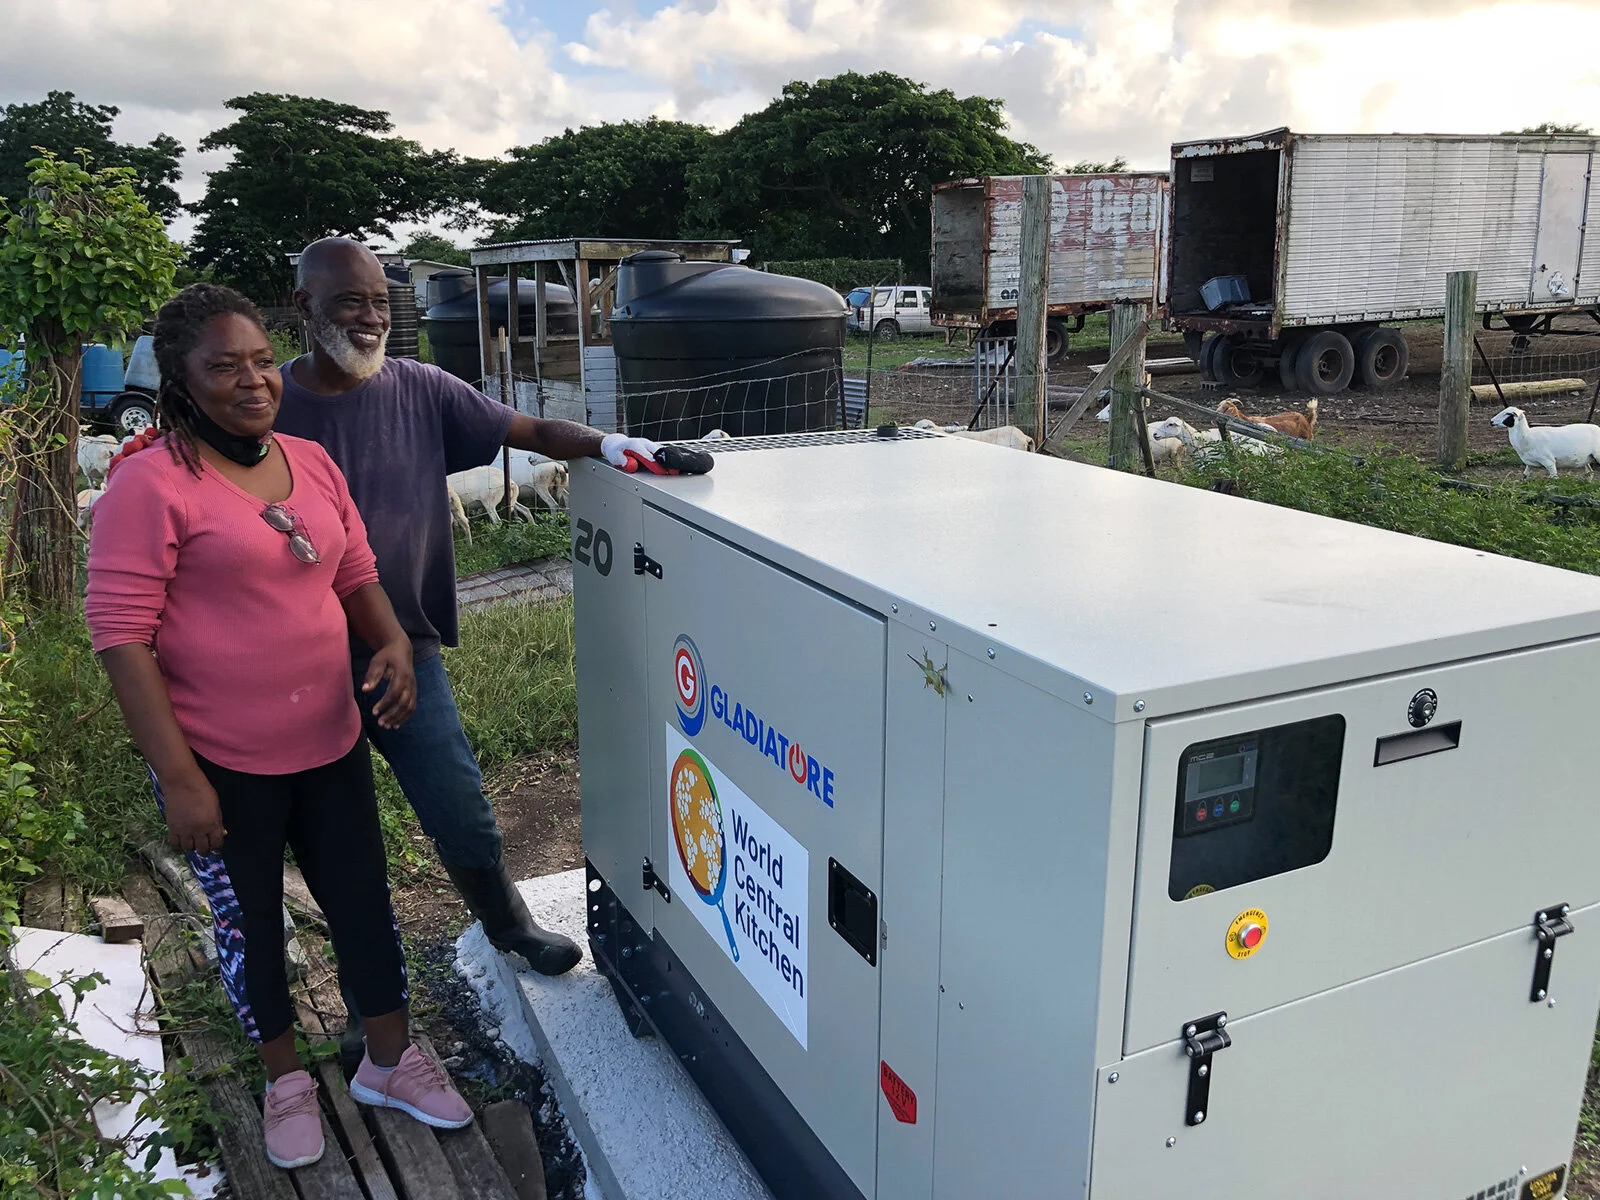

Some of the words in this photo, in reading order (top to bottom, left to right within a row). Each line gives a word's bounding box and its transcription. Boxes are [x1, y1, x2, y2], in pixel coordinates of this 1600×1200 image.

[575, 517, 613, 577] 20
[710, 684, 834, 808] GLADIATORE
[732, 808, 783, 889] World
[734, 855, 799, 950] Central
[1235, 910, 1265, 925] EMERGENCY
[735, 893, 804, 999] Kitchen
[1237, 950, 1251, 958] STOP
[883, 1066, 915, 1105] BATTERY
